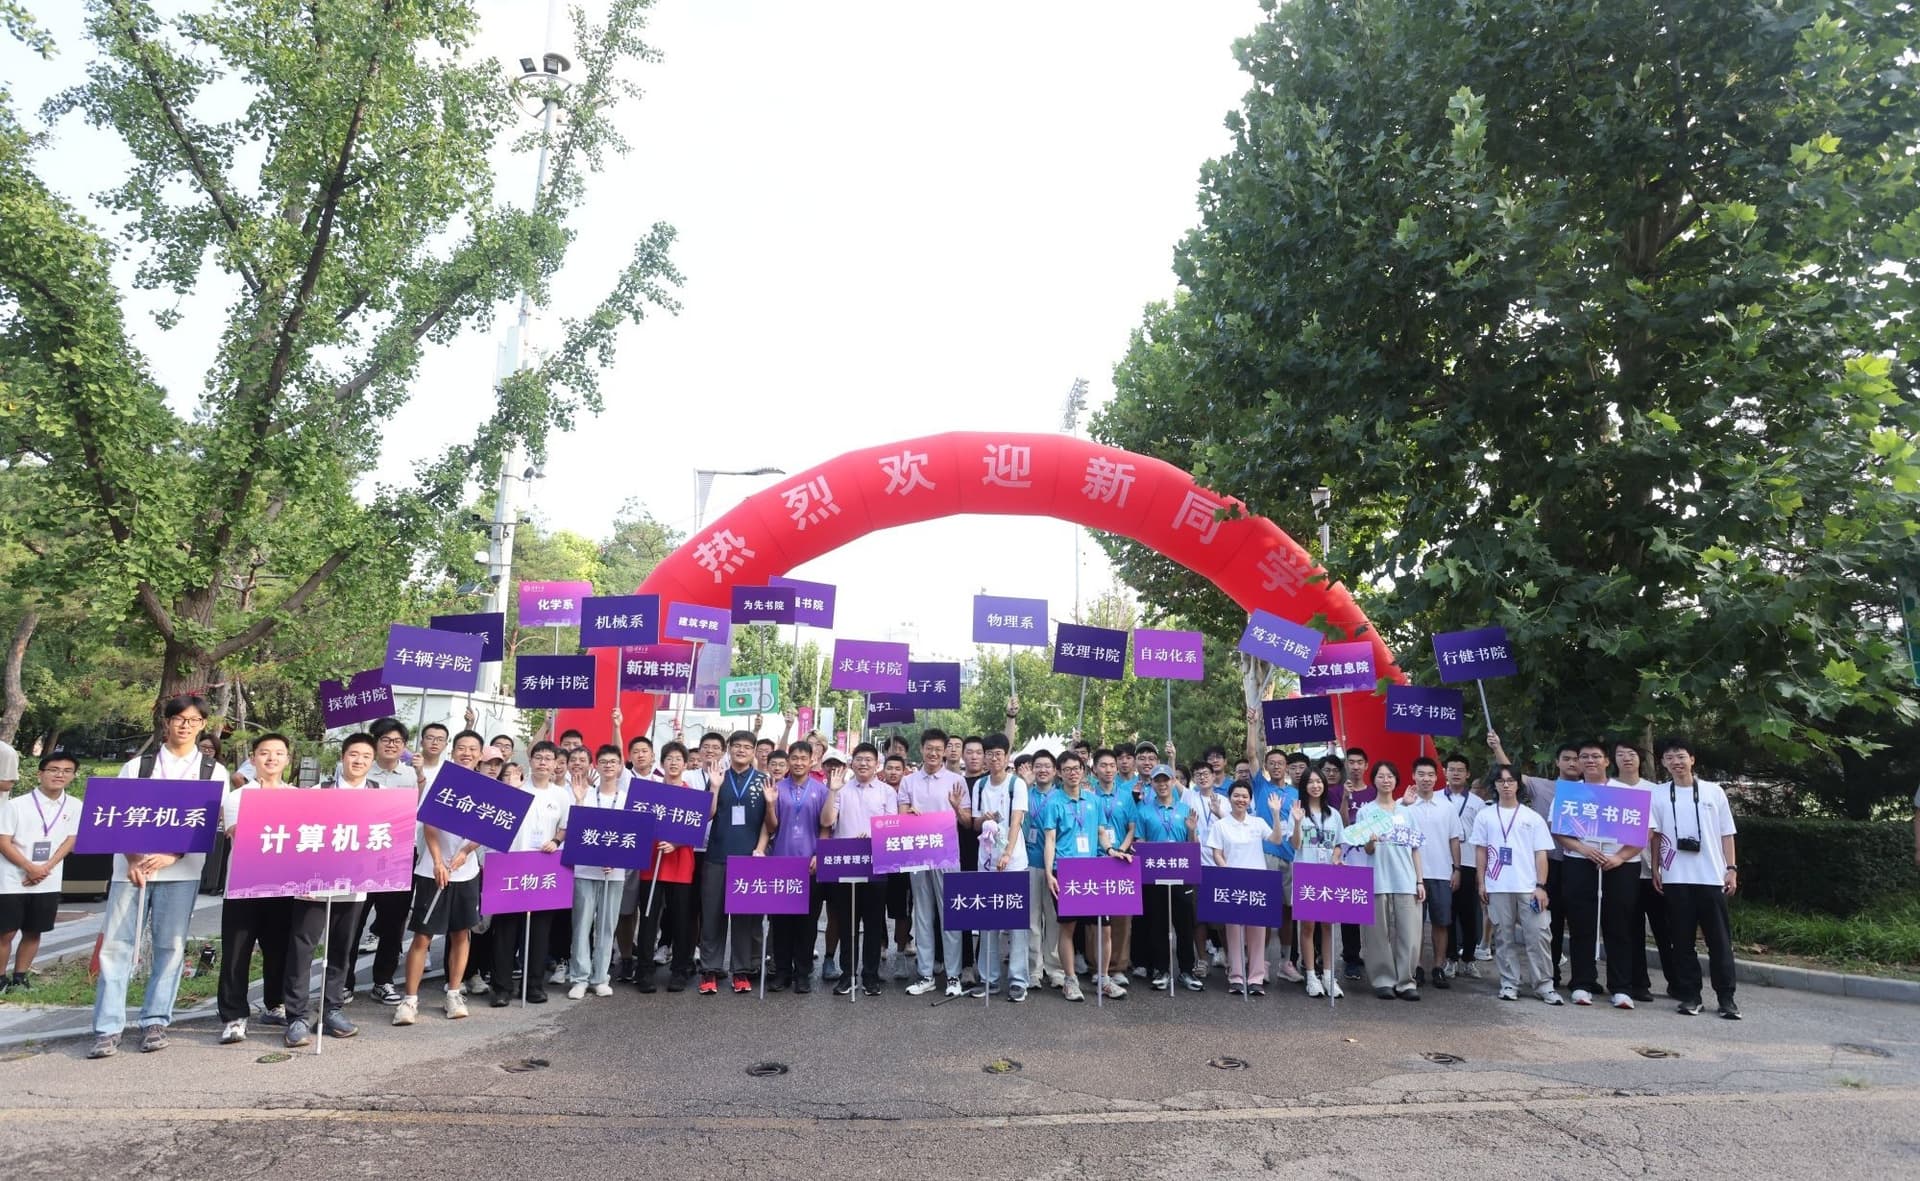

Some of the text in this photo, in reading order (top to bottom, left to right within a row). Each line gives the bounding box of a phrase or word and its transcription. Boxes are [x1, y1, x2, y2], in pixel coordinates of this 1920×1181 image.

[692, 444, 1309, 598] 热烈欢迎新同学
[537, 598, 574, 610] 化学系
[744, 600, 785, 610] 为先书院
[595, 614, 644, 630] 机械系
[678, 616, 719, 631] 建筑学院
[987, 613, 1034, 629] 物理系
[1251, 625, 1311, 660] 笃实书院
[393, 648, 473, 672] 车辆学院
[1061, 642, 1121, 663] 致理书院
[1141, 647, 1197, 664] 自动化系
[1443, 645, 1508, 666] 行健书院
[626, 660, 691, 677] 新雅书院
[839, 658, 902, 676] 求真书院
[1306, 660, 1370, 678] 交叉信息院
[522, 675, 590, 691] 秀钟书院
[327, 687, 388, 712] 探微书院
[1392, 703, 1456, 720] 无穹书院
[1270, 713, 1329, 730] 日新书院
[93, 806, 207, 828] 计算机系
[434, 787, 517, 830] 生命学院
[632, 800, 703, 827] 至善书院
[1560, 800, 1642, 826] 无穹书院
[259, 822, 393, 854] 计算机系
[580, 828, 637, 849] 数学系
[885, 833, 944, 852] 经管学院
[823, 855, 873, 865] 经济管理学
[1145, 857, 1190, 869] 未央书院
[500, 873, 557, 892] 工物系
[732, 879, 803, 895] 为先书院
[1064, 879, 1136, 896] 未央书院
[950, 893, 1024, 911] 水木书院
[1213, 887, 1267, 907] 医学院
[1299, 885, 1368, 905] 美术学院
